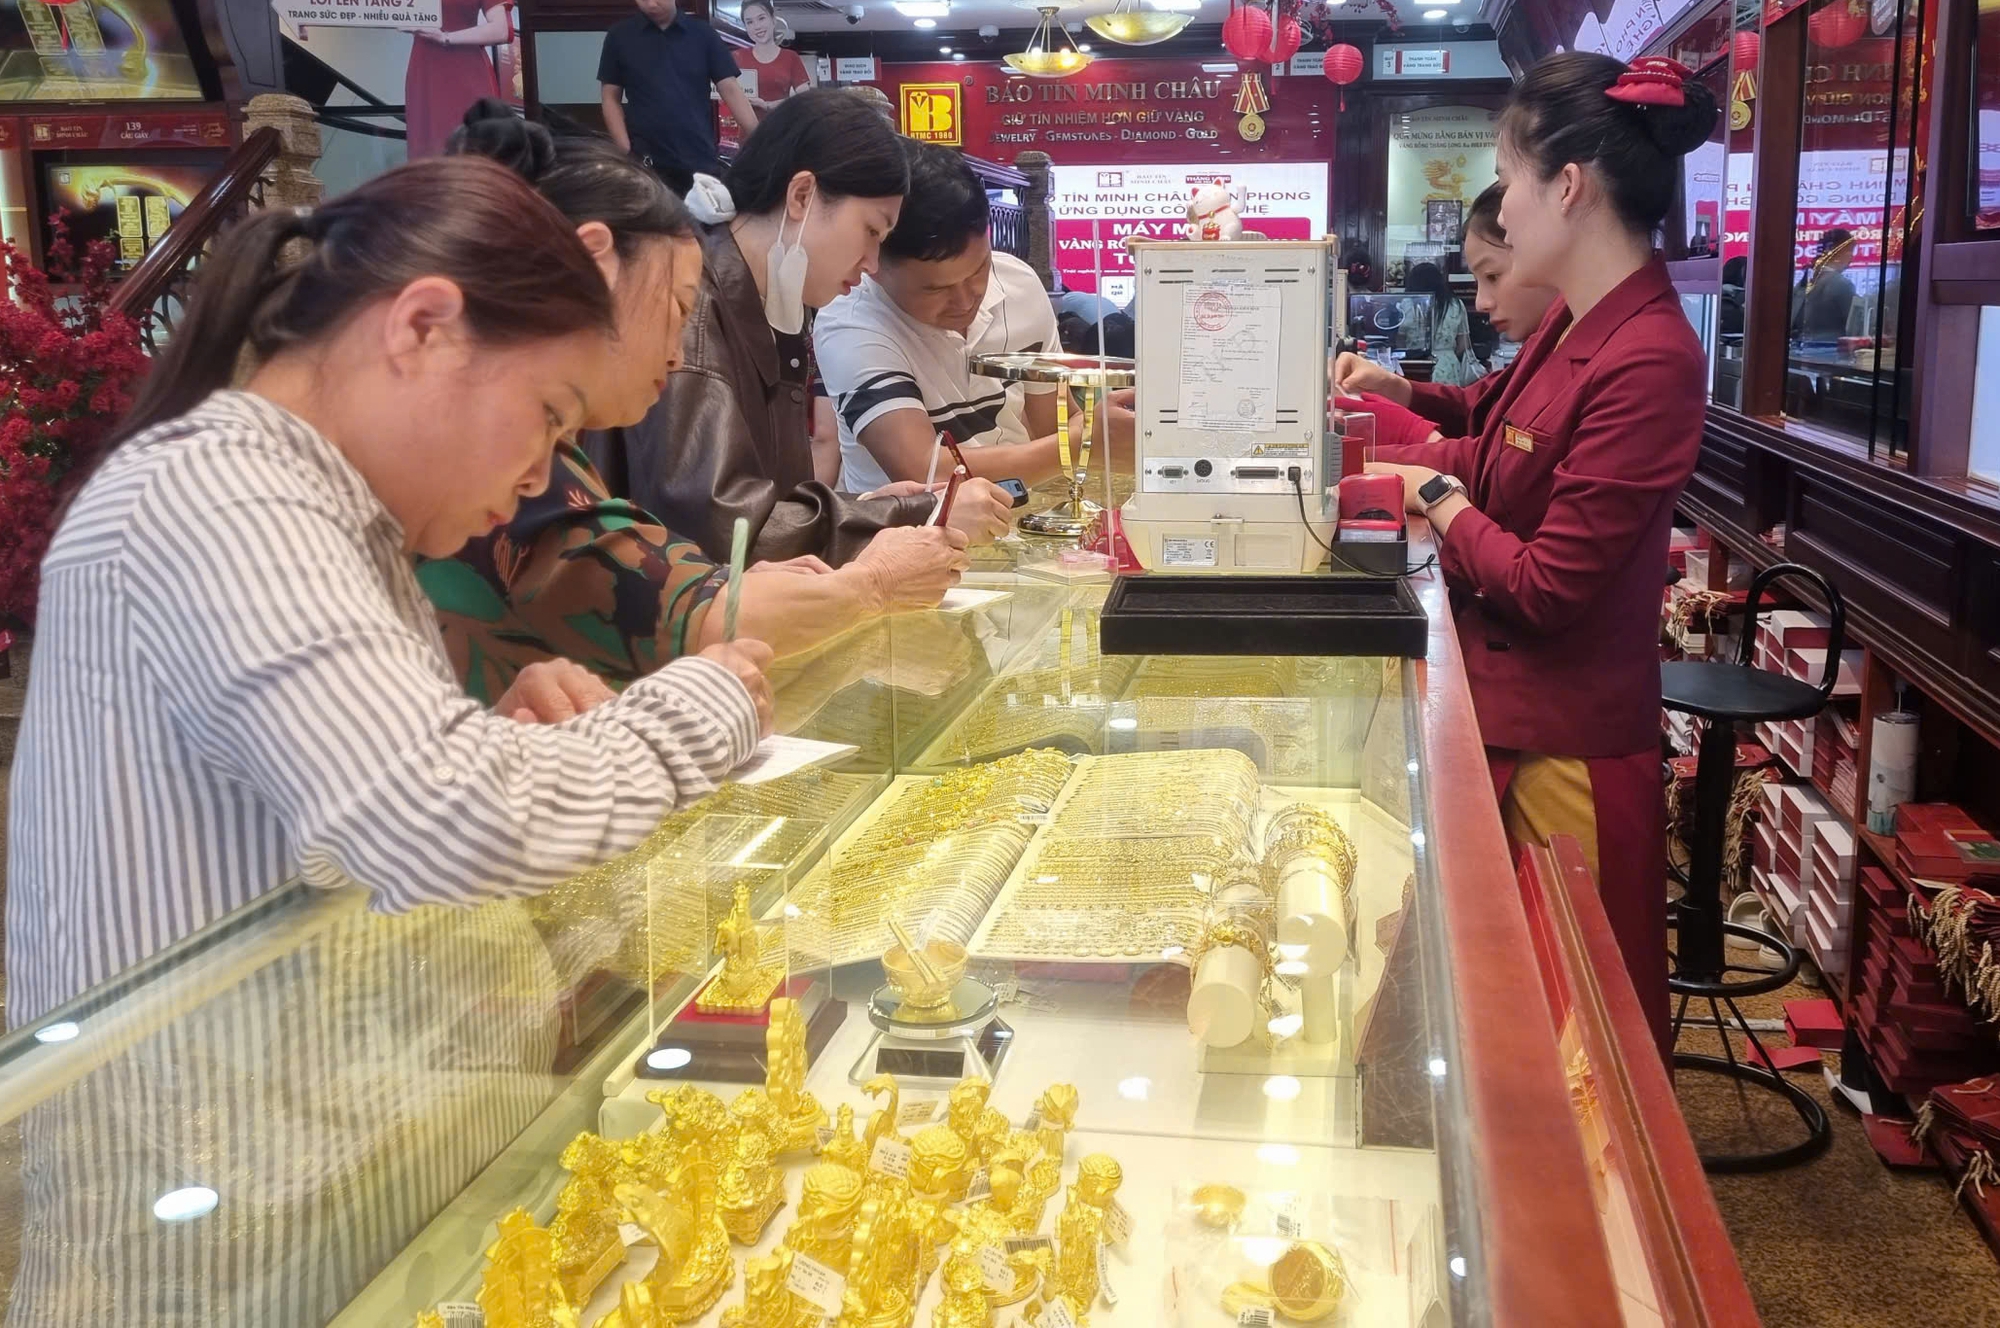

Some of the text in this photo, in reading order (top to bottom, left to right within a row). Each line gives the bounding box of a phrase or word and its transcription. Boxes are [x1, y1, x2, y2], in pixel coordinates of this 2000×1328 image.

[288, 9, 438, 23] TRANG SỨC ĐẸP NHIỀU QUÀ TẶNG
[986, 78, 1222, 103] BẢO TÍN MINH CHÂU
[1030, 110, 1051, 125] TÍN
[1055, 110, 1098, 126] NHIỆM
[1102, 110, 1133, 124] HƠN
[1136, 109, 1163, 124] GIỮ
[1165, 108, 1205, 123] VÀNG
[126, 122, 141, 131] 139
[989, 127, 1218, 143] JEWELRY GEMSTONES DIAMOND GOLD
[1062, 192, 1088, 202] TÍN
[1095, 193, 1138, 202] MINH
[1145, 191, 1192, 202] CHÂU
[1246, 191, 1310, 201] PHONG
[1058, 204, 1104, 215] ỨNG
[1110, 205, 1156, 217] DỤNG
[1160, 203, 1186, 215] CÔ
[1113, 220, 1168, 235] MÁY
[1058, 237, 1103, 250] VÀNG
